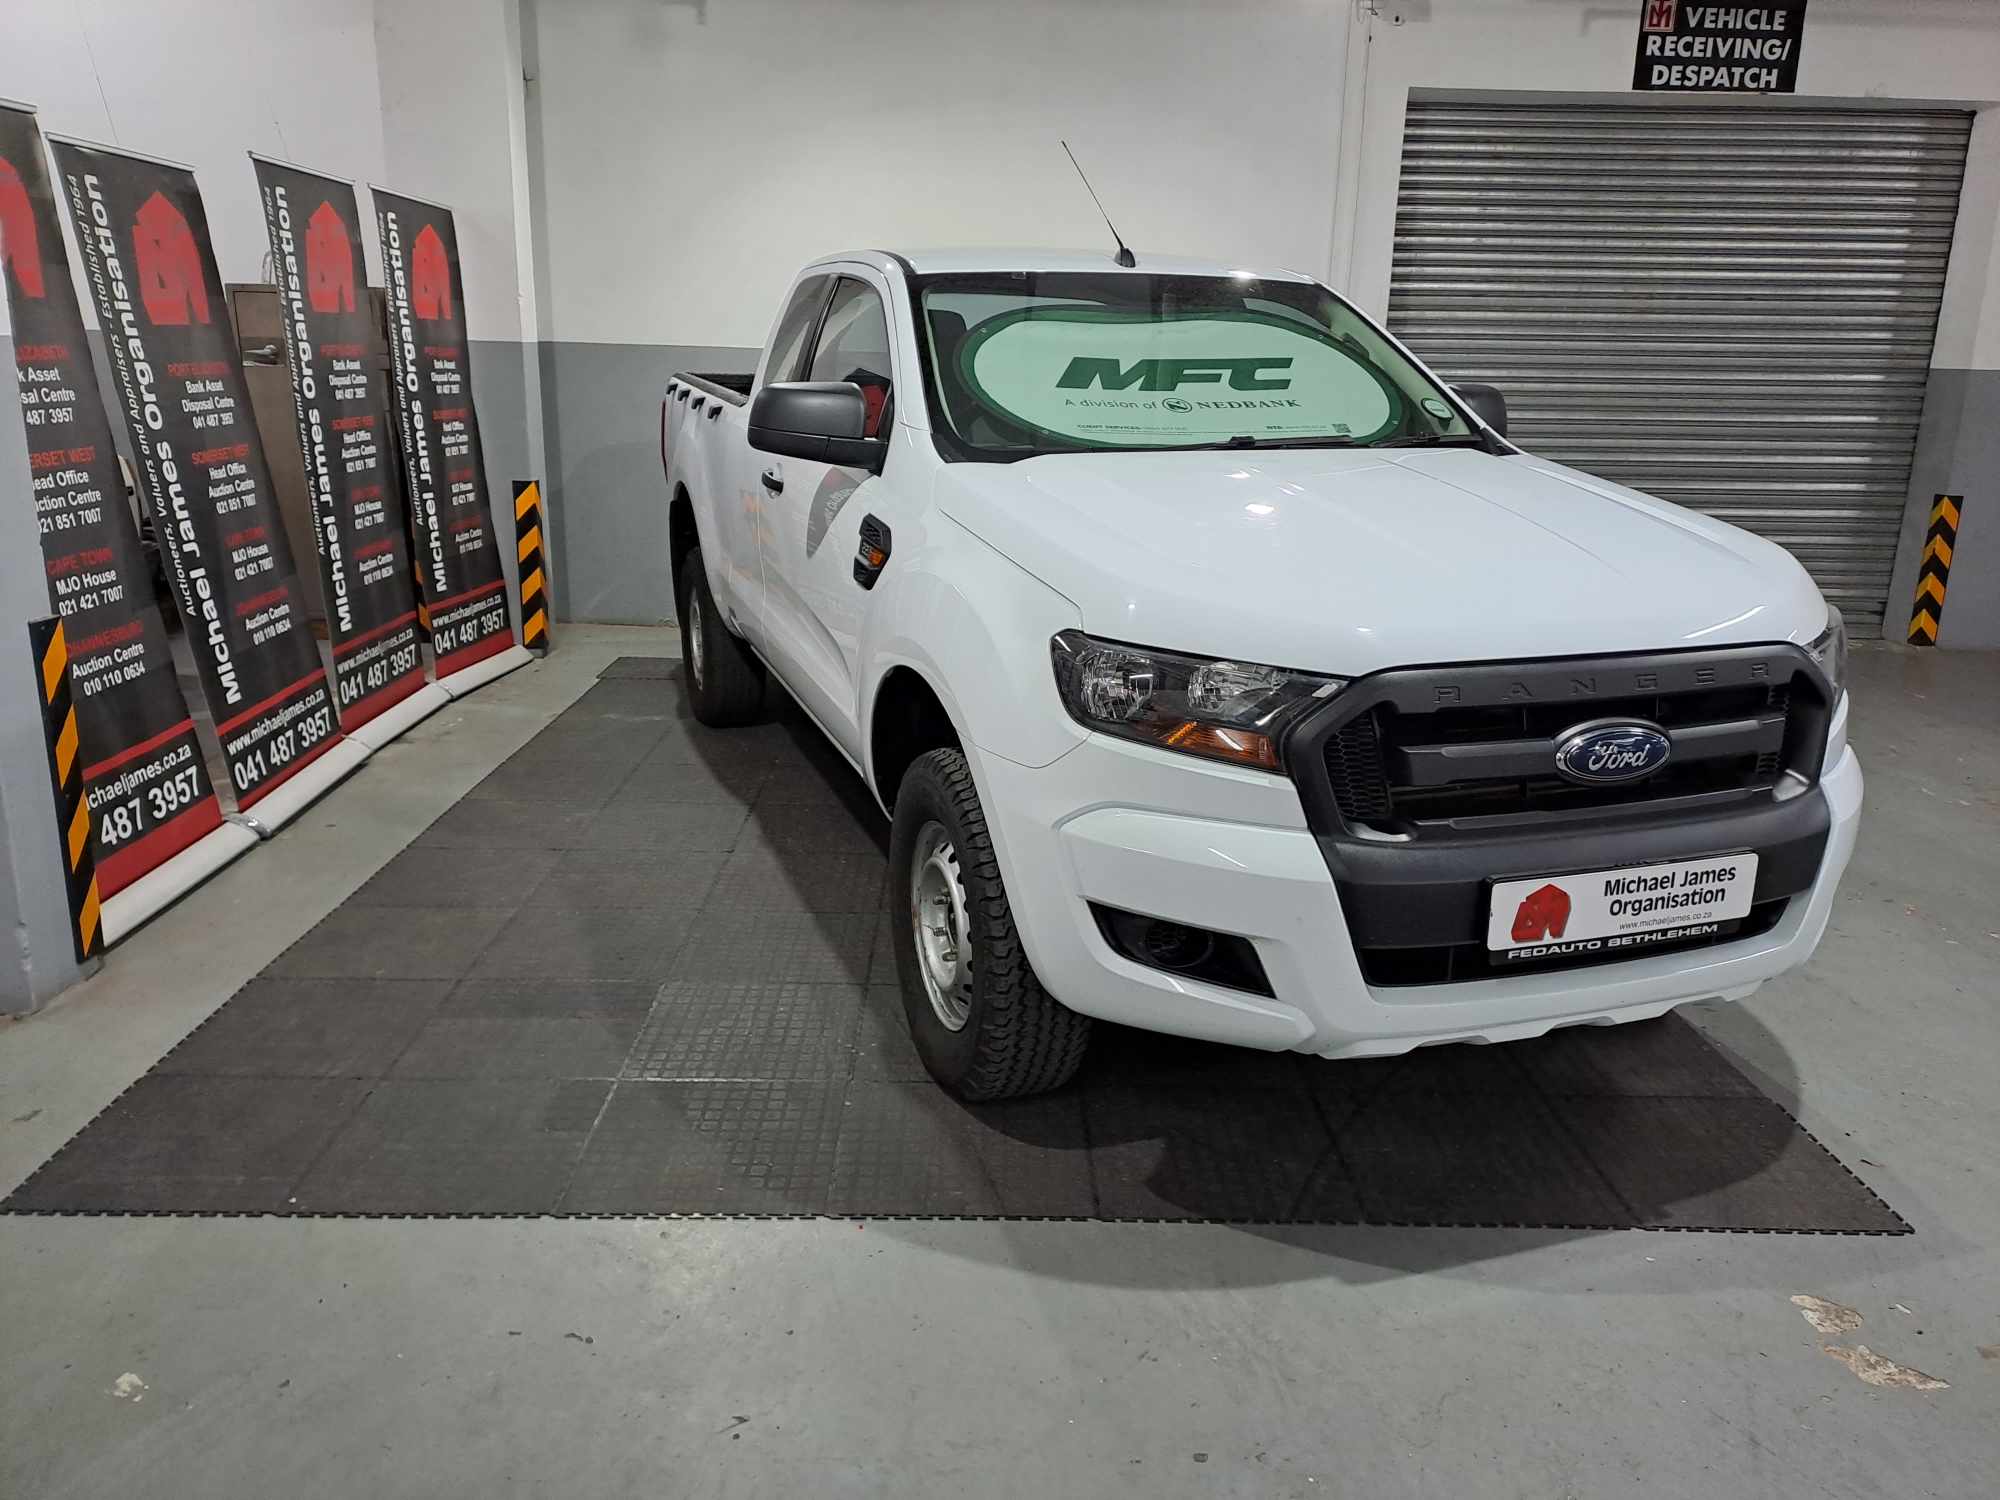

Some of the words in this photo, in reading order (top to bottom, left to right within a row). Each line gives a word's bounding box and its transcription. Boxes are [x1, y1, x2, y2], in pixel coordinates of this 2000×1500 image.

[1686, 7, 1787, 31] VEHICLE
[1645, 35, 1792, 61] RECEIVING/
[1651, 64, 1779, 89] DESPATCH
[66, 174, 86, 217] 1964
[78, 221, 113, 319] Established
[84, 174, 163, 431] Organisation
[275, 186, 316, 399] Organisation
[387, 211, 419, 392] Organisation
[28, 366, 61, 382] Asset
[110, 333, 140, 420] Appraisers
[184, 380, 205, 394] Bank
[1055, 357, 1294, 391] MFC
[20, 389, 40, 404] sal
[41, 387, 76, 403] Centre
[181, 397, 214, 413] Disposal
[294, 392, 304, 419] and
[396, 385, 407, 409] and
[1065, 399, 1077, 407] A
[1079, 399, 1139, 409] division
[1199, 399, 1302, 409] NEDBANK
[26, 410, 46, 425] 487
[49, 407, 74, 424] 3957
[133, 423, 150, 455] and
[411, 400, 432, 486] James
[208, 465, 227, 480] Head
[226, 462, 247, 477] Office
[308, 408, 334, 507] James
[32, 472, 55, 490] ead
[56, 470, 89, 487] Office
[144, 458, 167, 517] Valuers
[208, 483, 235, 498] Auction
[68, 488, 102, 506] Centre
[156, 441, 201, 558] James
[56, 511, 77, 531] 851
[77, 507, 102, 525] 7007
[422, 492, 447, 593] Michael
[55, 576, 81, 596] MJO
[82, 569, 117, 588] House
[322, 515, 352, 633] Michael
[58, 599, 78, 617] 021
[79, 592, 100, 611] 421
[101, 585, 124, 604] 7007
[189, 567, 242, 705] Michael
[434, 627, 457, 654] 041
[460, 619, 478, 643] 487
[480, 608, 504, 635] 3957
[72, 654, 113, 680] Auction
[113, 642, 145, 662] Centre
[340, 672, 364, 705] 041
[367, 659, 388, 689] 487
[390, 643, 416, 677] 3957
[83, 677, 102, 697] 010
[102, 669, 124, 690] 110
[124, 659, 146, 681] 0634
[1434, 663, 1768, 703] RANGER
[226, 688, 326, 757] www.michaeljames.co.za
[234, 749, 268, 790] 041
[269, 729, 296, 767] 487
[297, 706, 332, 748] 3957
[1587, 741, 1649, 771] Ford
[100, 797, 144, 846] 487
[148, 764, 200, 819] 3957
[1603, 871, 1676, 897] Michael
[1680, 866, 1737, 891] James
[1609, 888, 1726, 917] Organisation
[1618, 911, 1713, 931] www.michaeljames.co.za
[1507, 940, 1602, 960] FEDAUTO
[1607, 924, 1719, 948] BETHLEHEM
